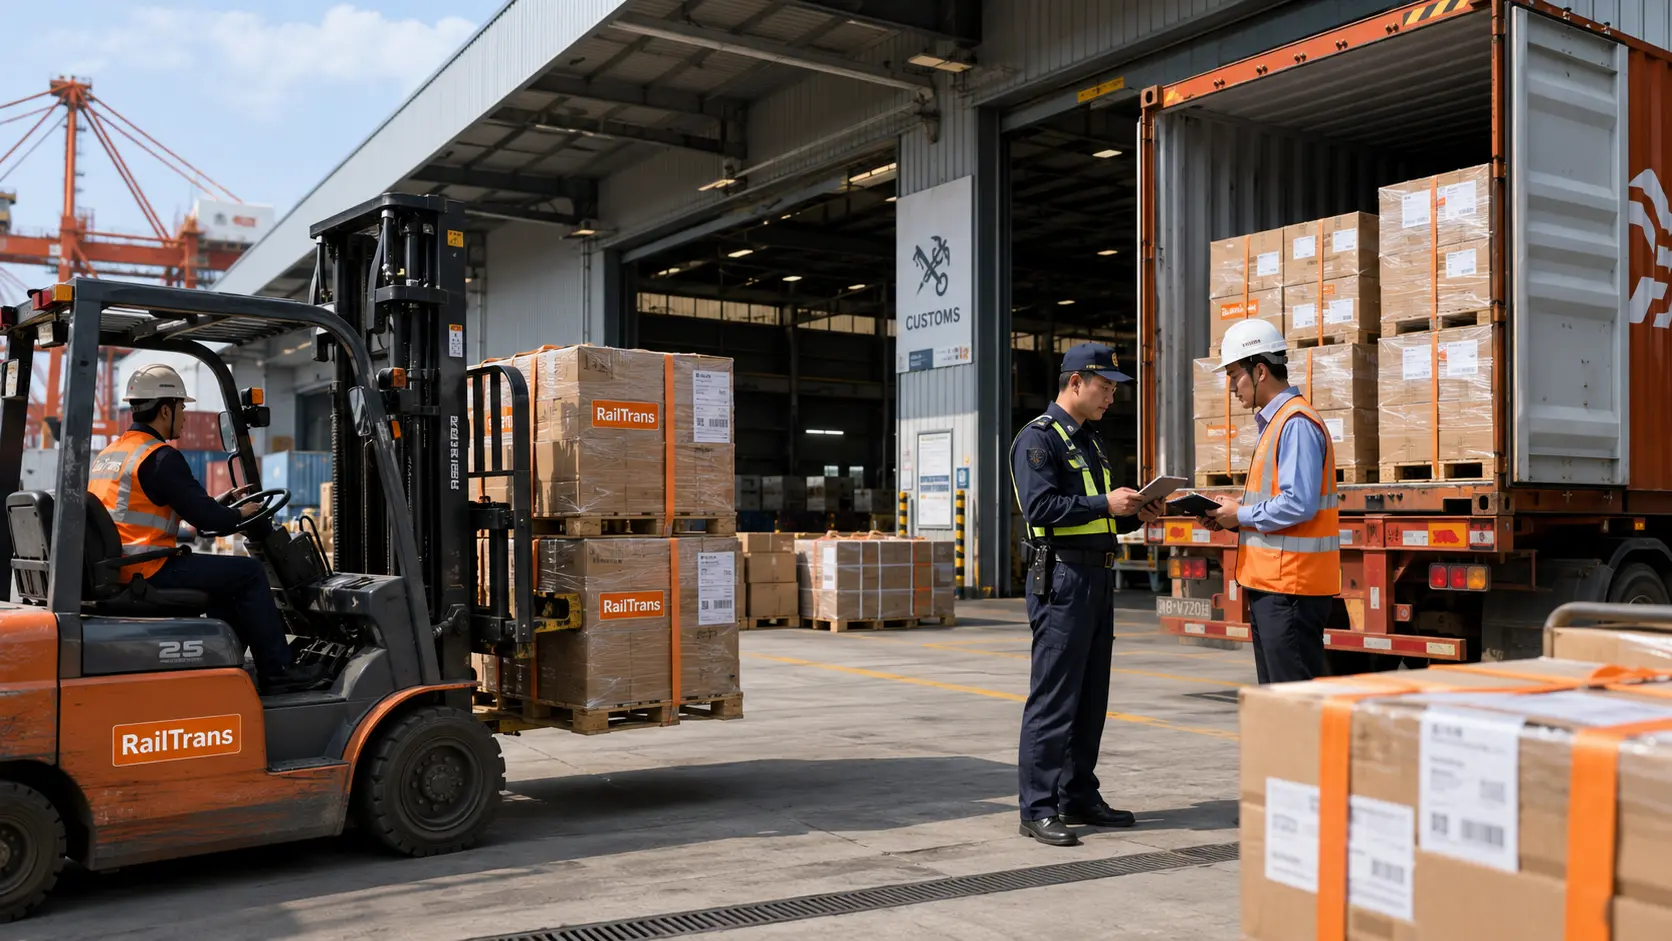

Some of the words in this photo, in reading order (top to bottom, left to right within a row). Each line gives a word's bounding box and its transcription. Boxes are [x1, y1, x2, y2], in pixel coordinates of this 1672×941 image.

[906, 307, 960, 331] CUSTOMS
[596, 407, 655, 424] RailTrans
[603, 598, 661, 614] RailTrans
[159, 640, 204, 659] 25
[122, 728, 233, 756] RailTrans
